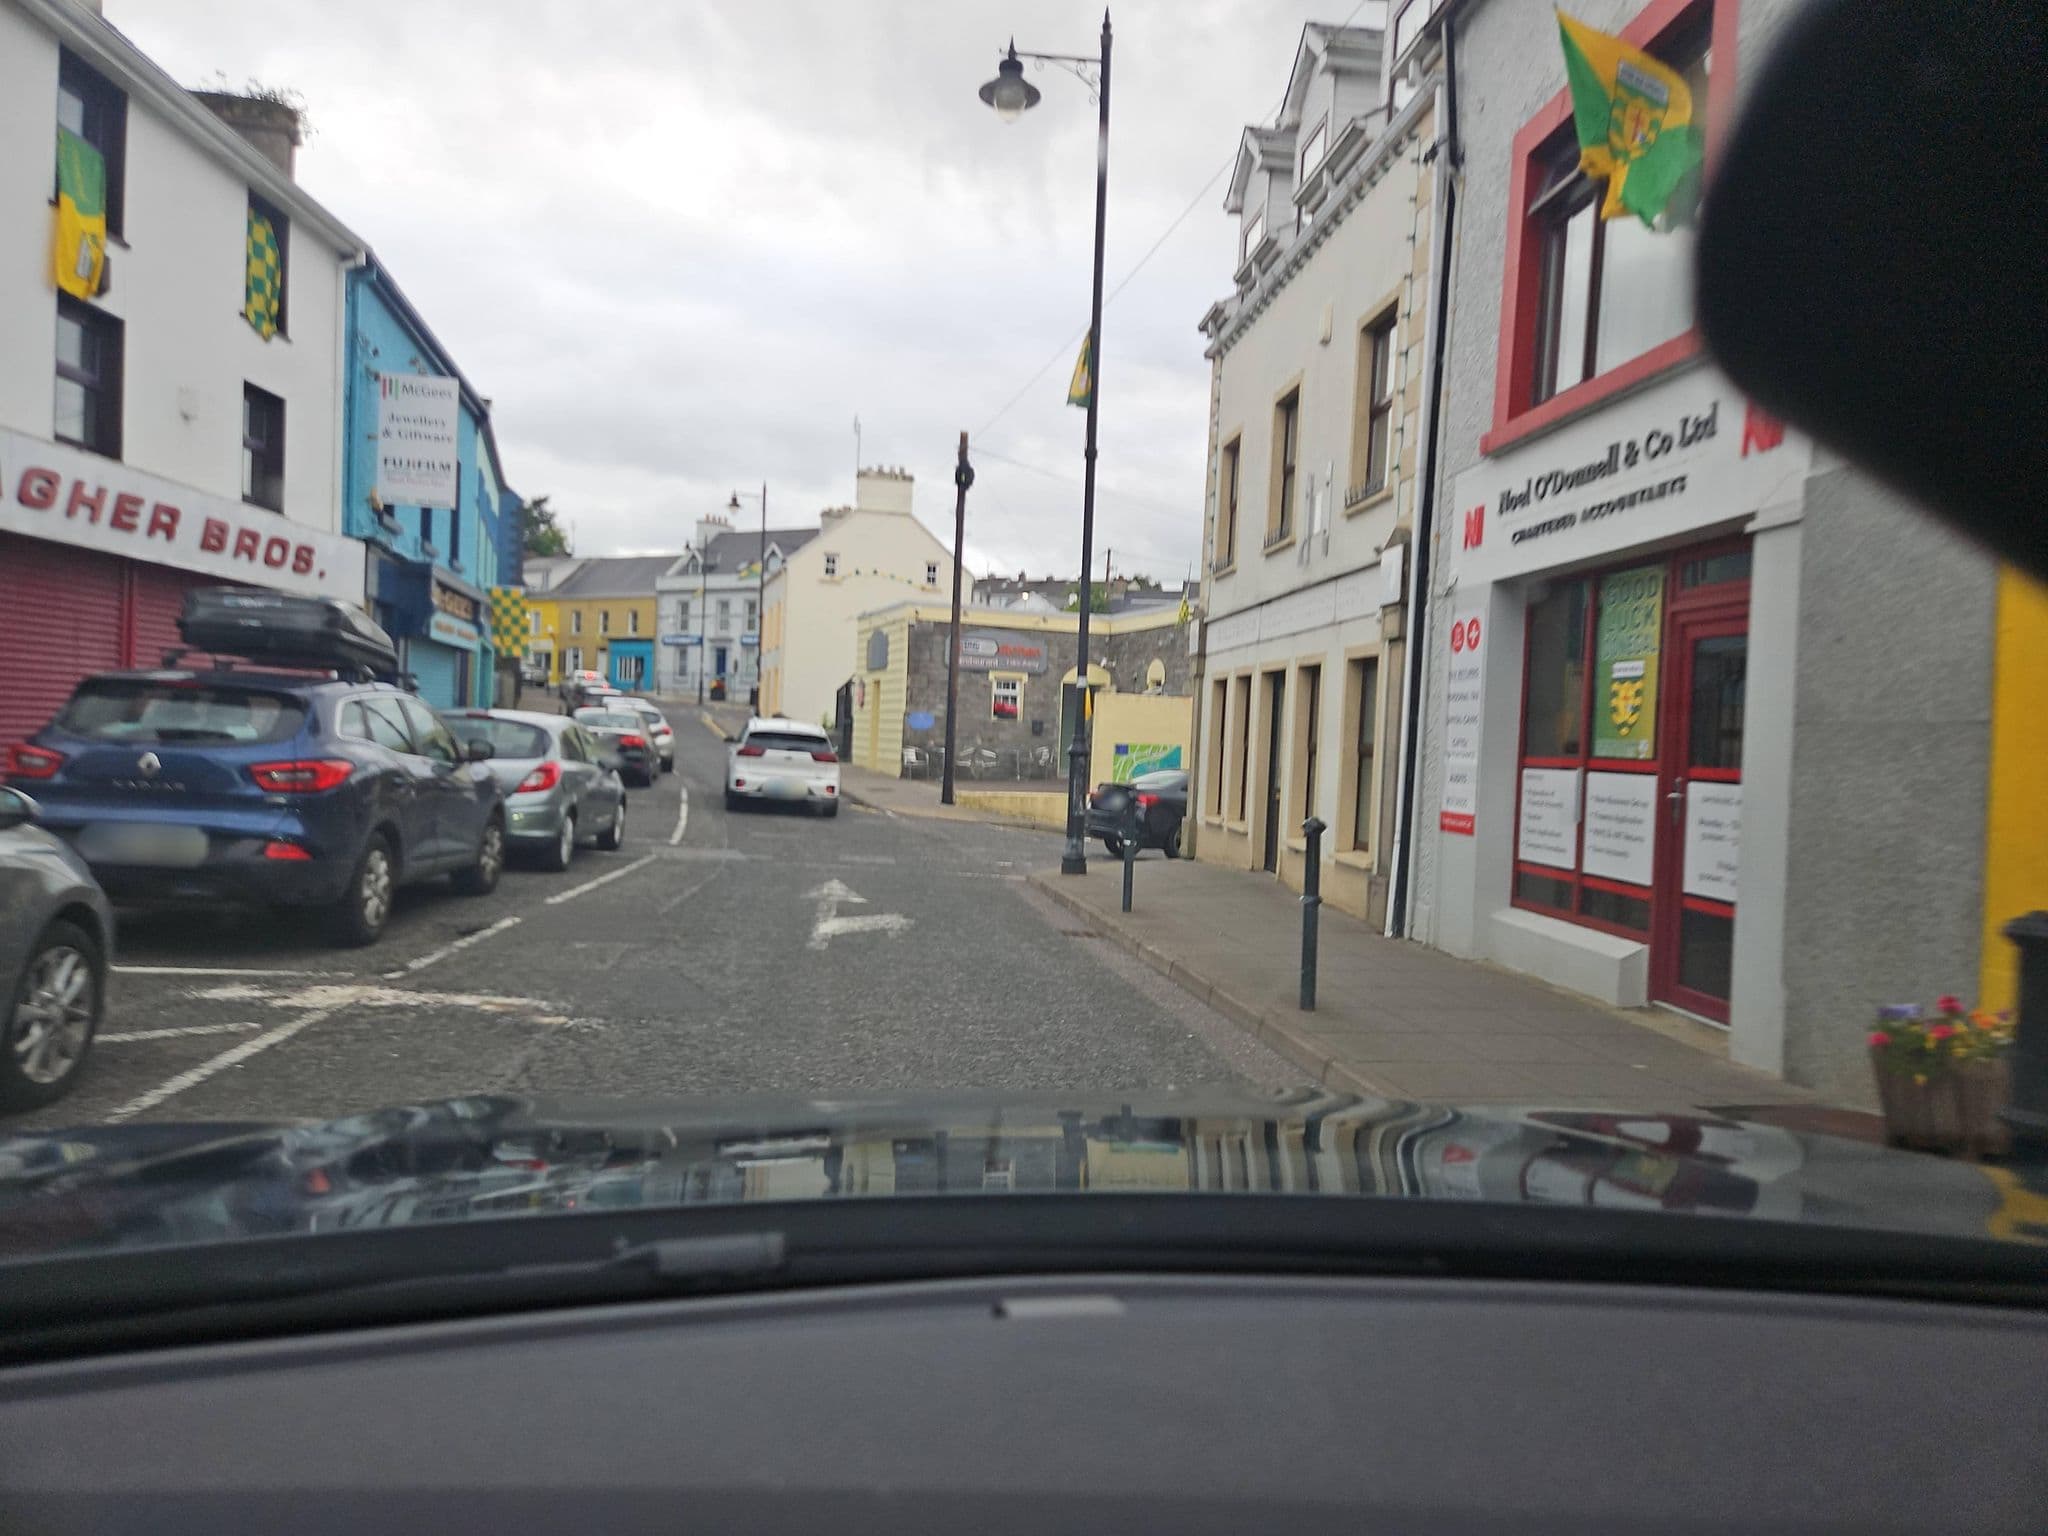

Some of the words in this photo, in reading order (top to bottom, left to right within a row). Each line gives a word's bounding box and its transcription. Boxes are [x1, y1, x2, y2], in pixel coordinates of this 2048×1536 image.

[1534, 440, 1621, 502] O'Donnell
[1624, 440, 1640, 469] &
[1644, 429, 1674, 460] Co
[1678, 401, 1719, 448] Ltd
[0, 464, 182, 542] GHER
[200, 514, 327, 580] BROS.
